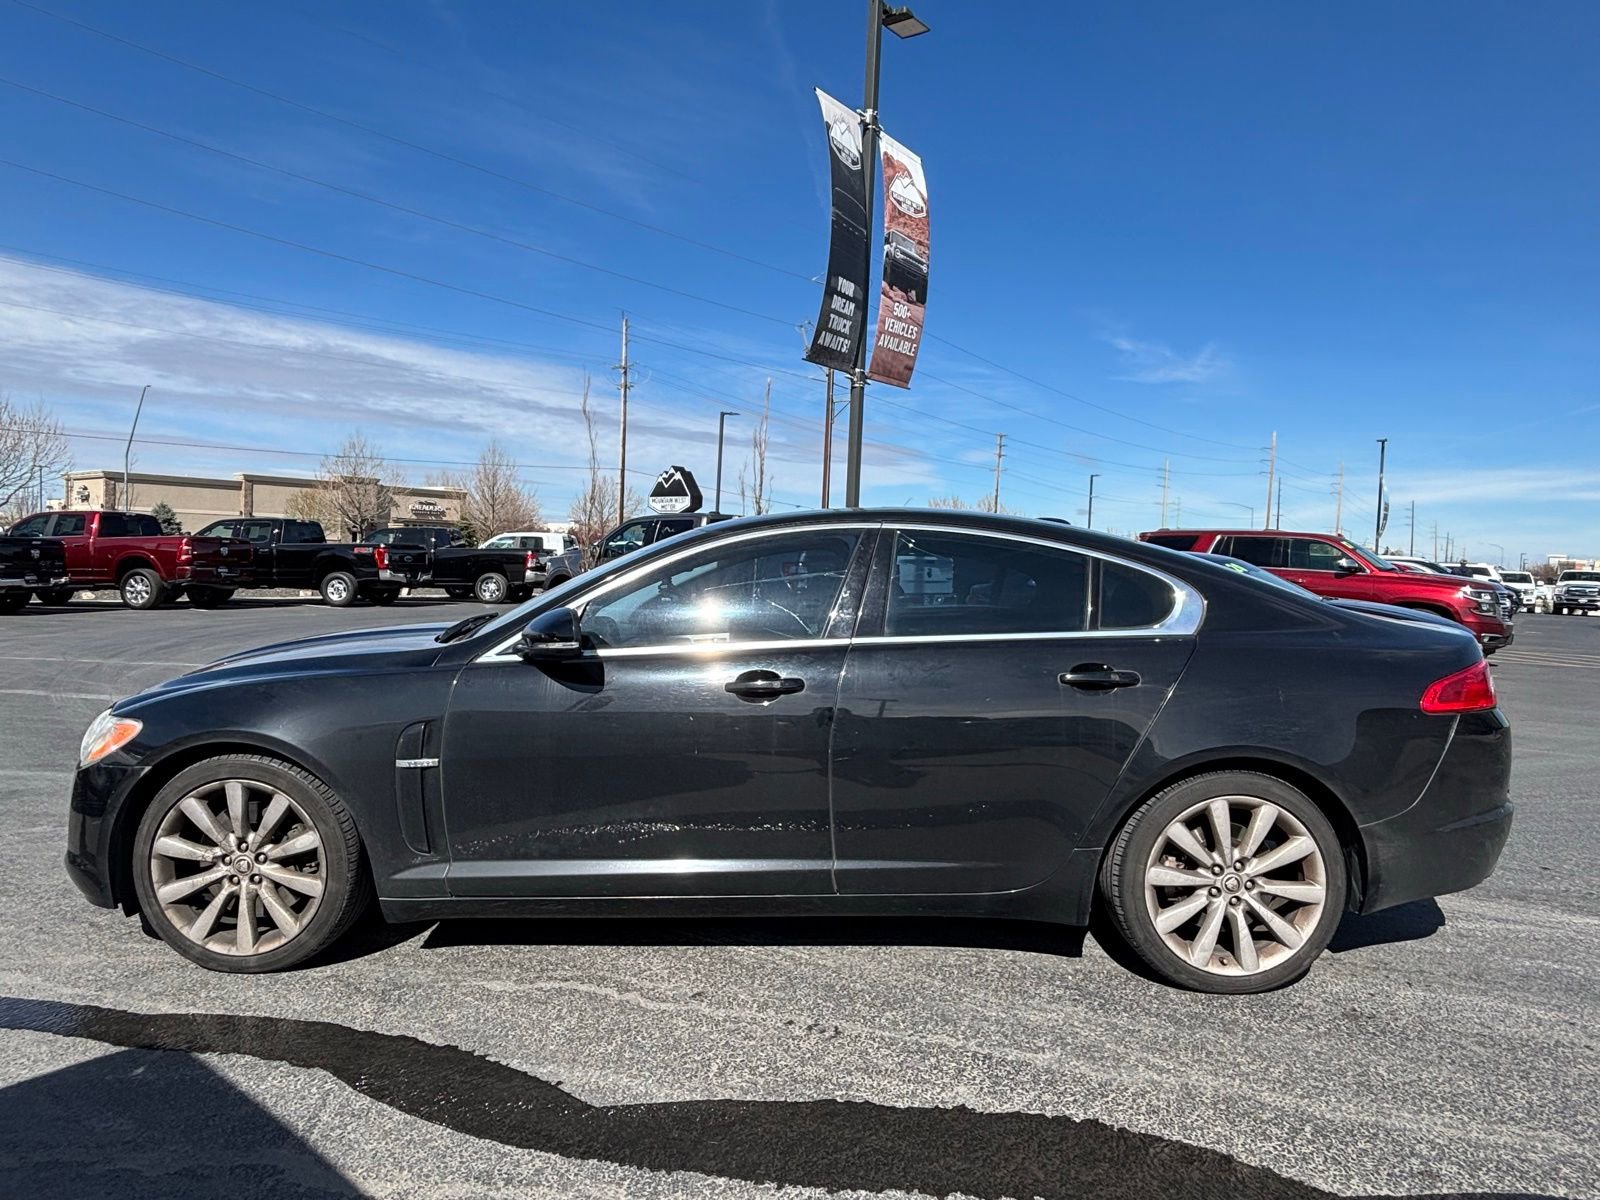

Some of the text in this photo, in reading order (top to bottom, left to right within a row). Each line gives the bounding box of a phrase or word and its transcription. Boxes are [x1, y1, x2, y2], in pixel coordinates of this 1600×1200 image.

[838, 276, 855, 297] YOUR
[831, 294, 855, 316] DREAM
[893, 302, 912, 319] 500+
[828, 313, 852, 335] TRUCK
[885, 317, 918, 339] VEHICLES
[817, 331, 851, 353] AWAITS!
[878, 334, 917, 356] AVAILABLE
